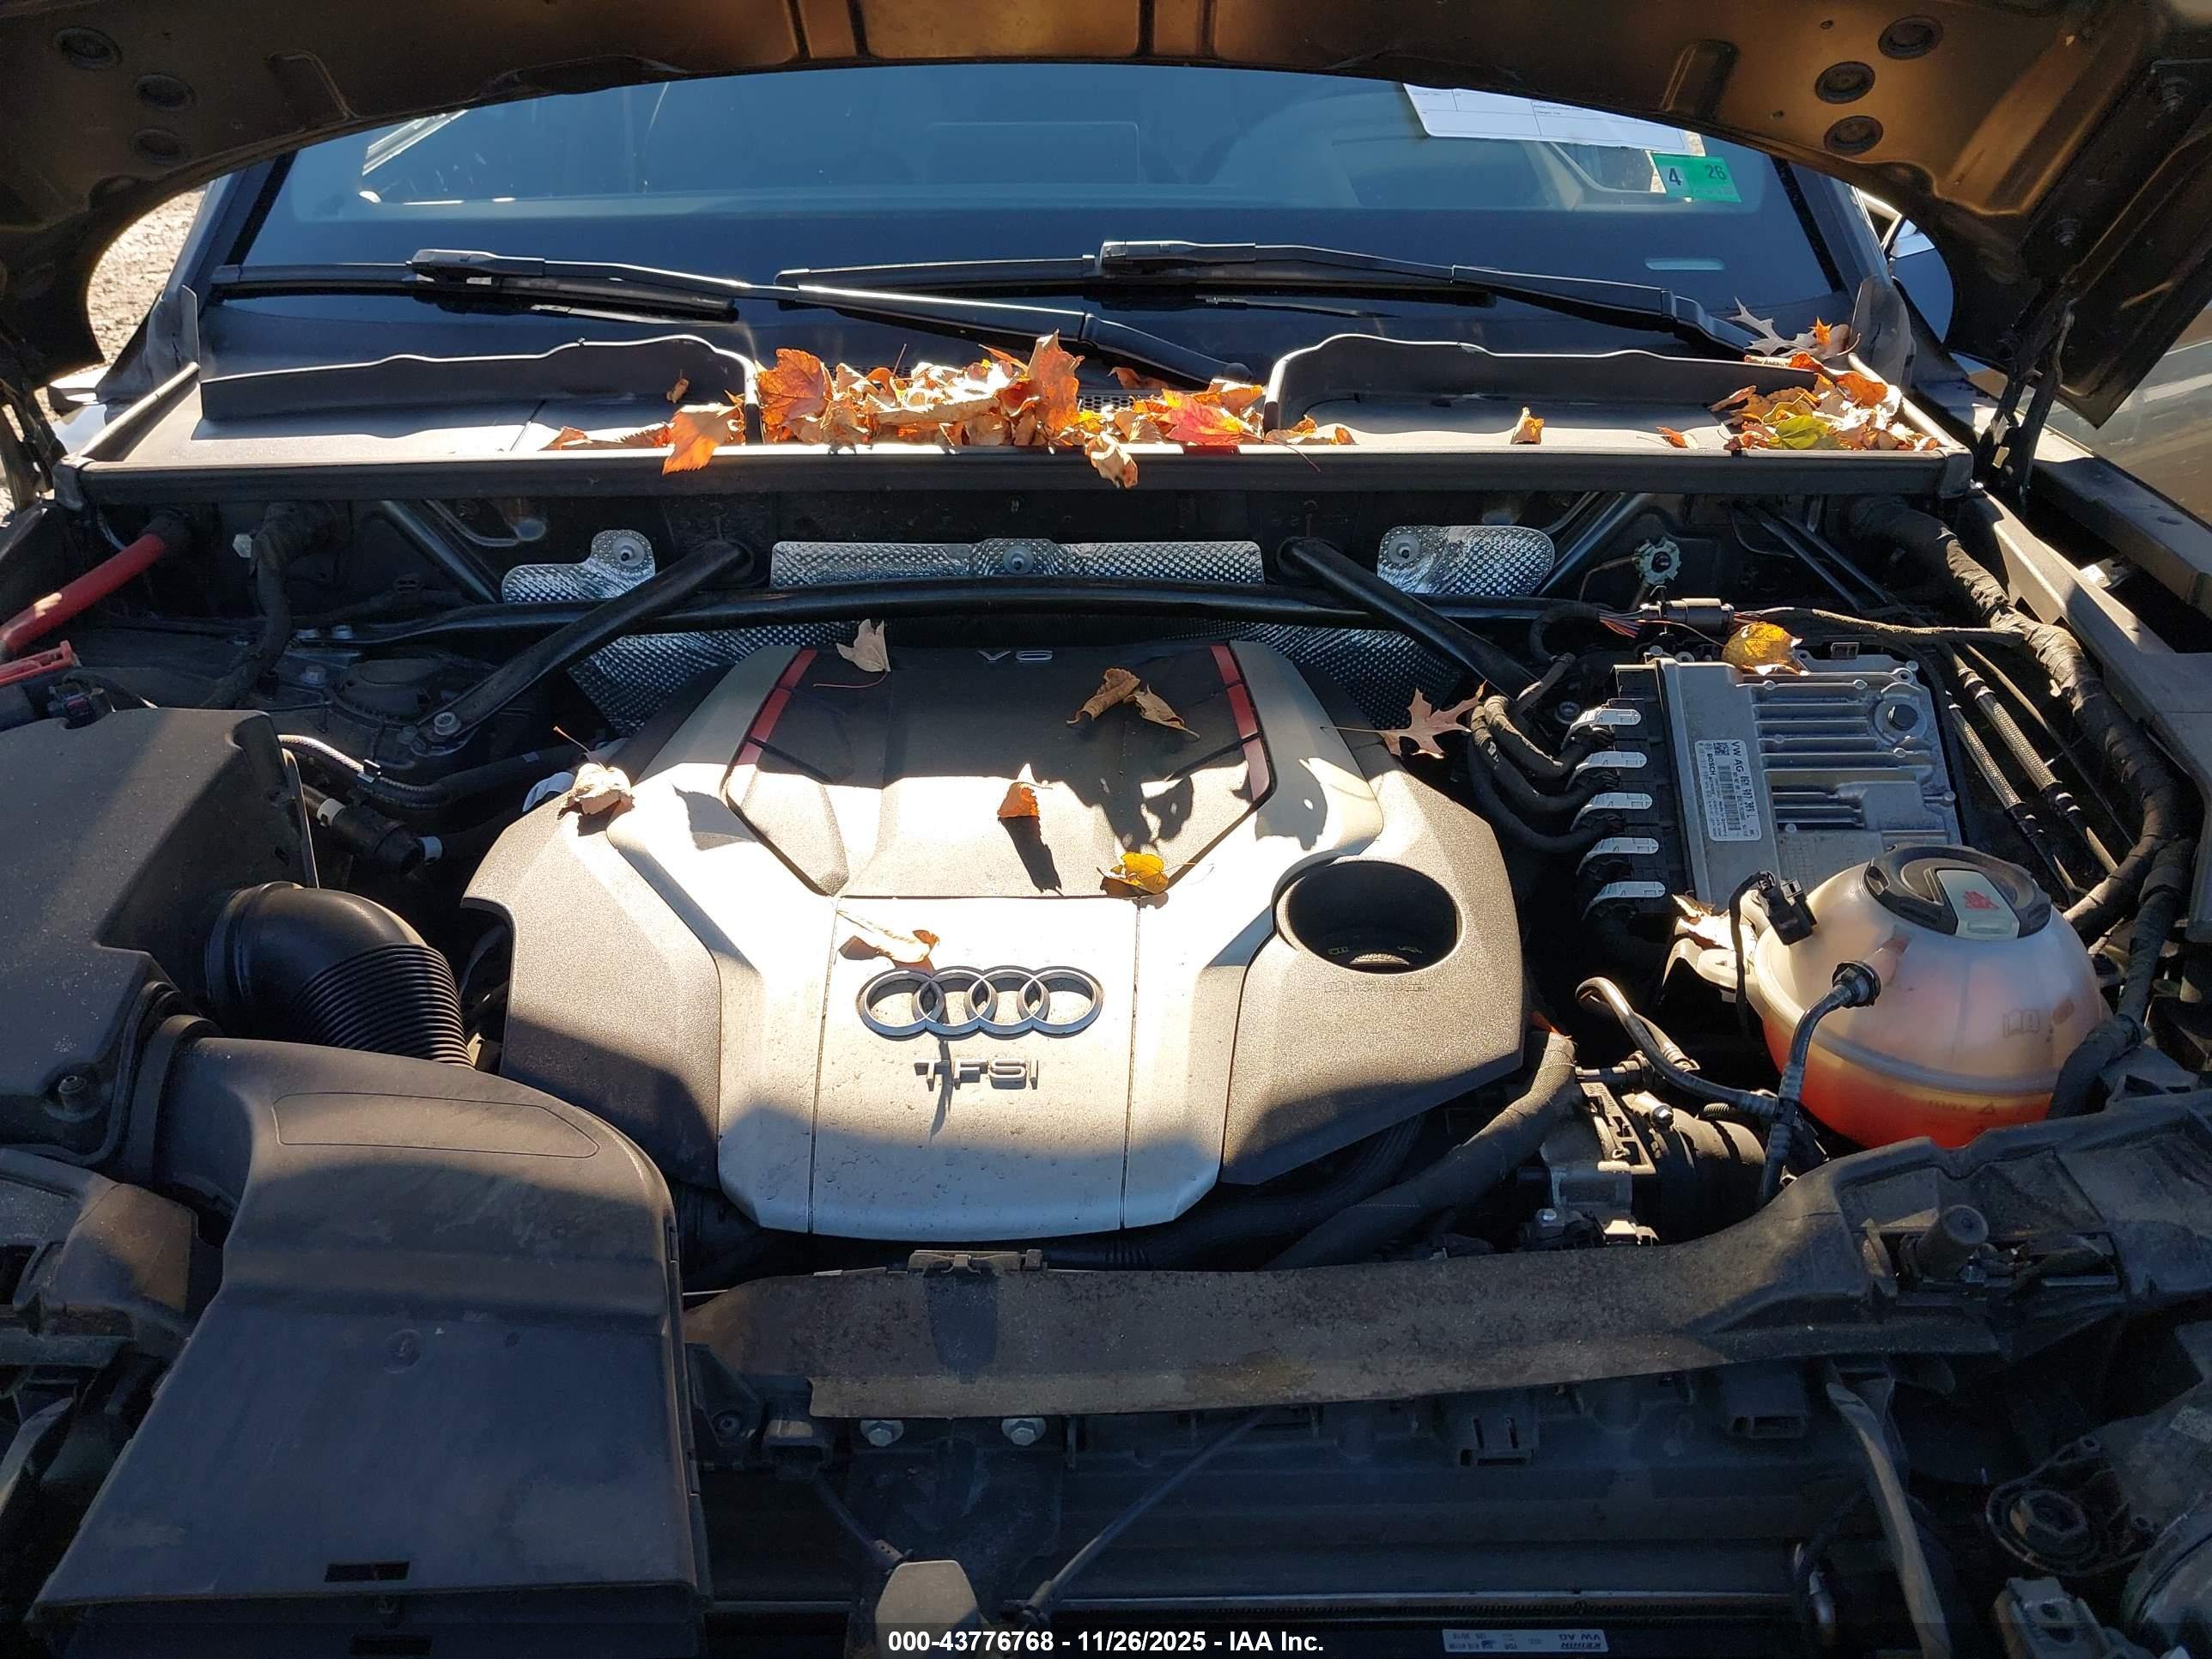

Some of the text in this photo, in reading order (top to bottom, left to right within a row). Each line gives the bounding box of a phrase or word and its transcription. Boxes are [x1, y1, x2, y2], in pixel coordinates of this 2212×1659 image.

[1668, 164, 1726, 186] 4 26
[977, 650, 1053, 662] V6
[1731, 741, 1742, 757] VW
[1706, 753, 1717, 775] BOSCH
[1735, 759, 1744, 773] AG
[915, 1058, 1038, 1085] TFSI
